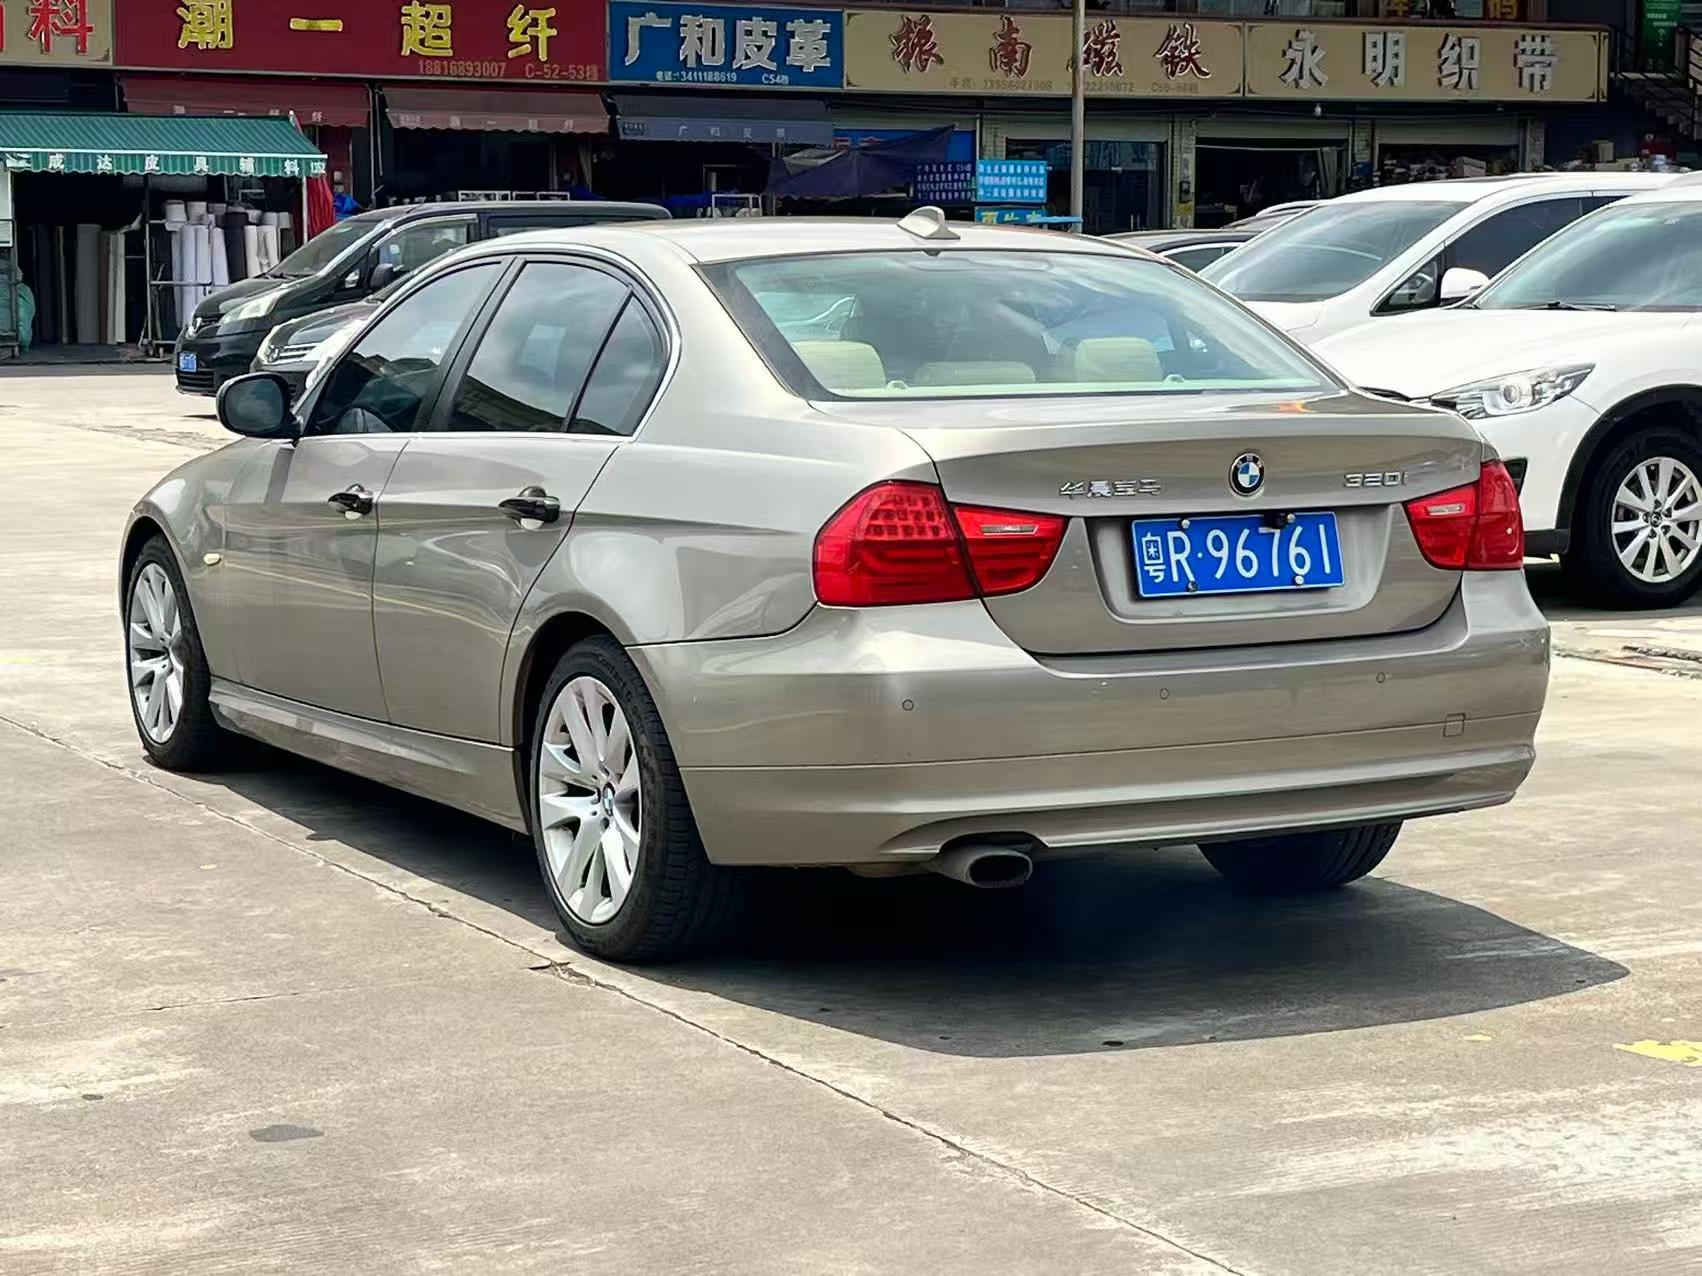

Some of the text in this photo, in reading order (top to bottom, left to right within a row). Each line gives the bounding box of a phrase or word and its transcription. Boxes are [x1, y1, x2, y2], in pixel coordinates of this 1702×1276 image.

[0, 0, 95, 55] 料
[178, 0, 557, 61] 潮一超纤
[625, 12, 832, 73] 广和皮革
[418, 60, 506, 78] 18816893007
[1281, 28, 1559, 92] 永明织带
